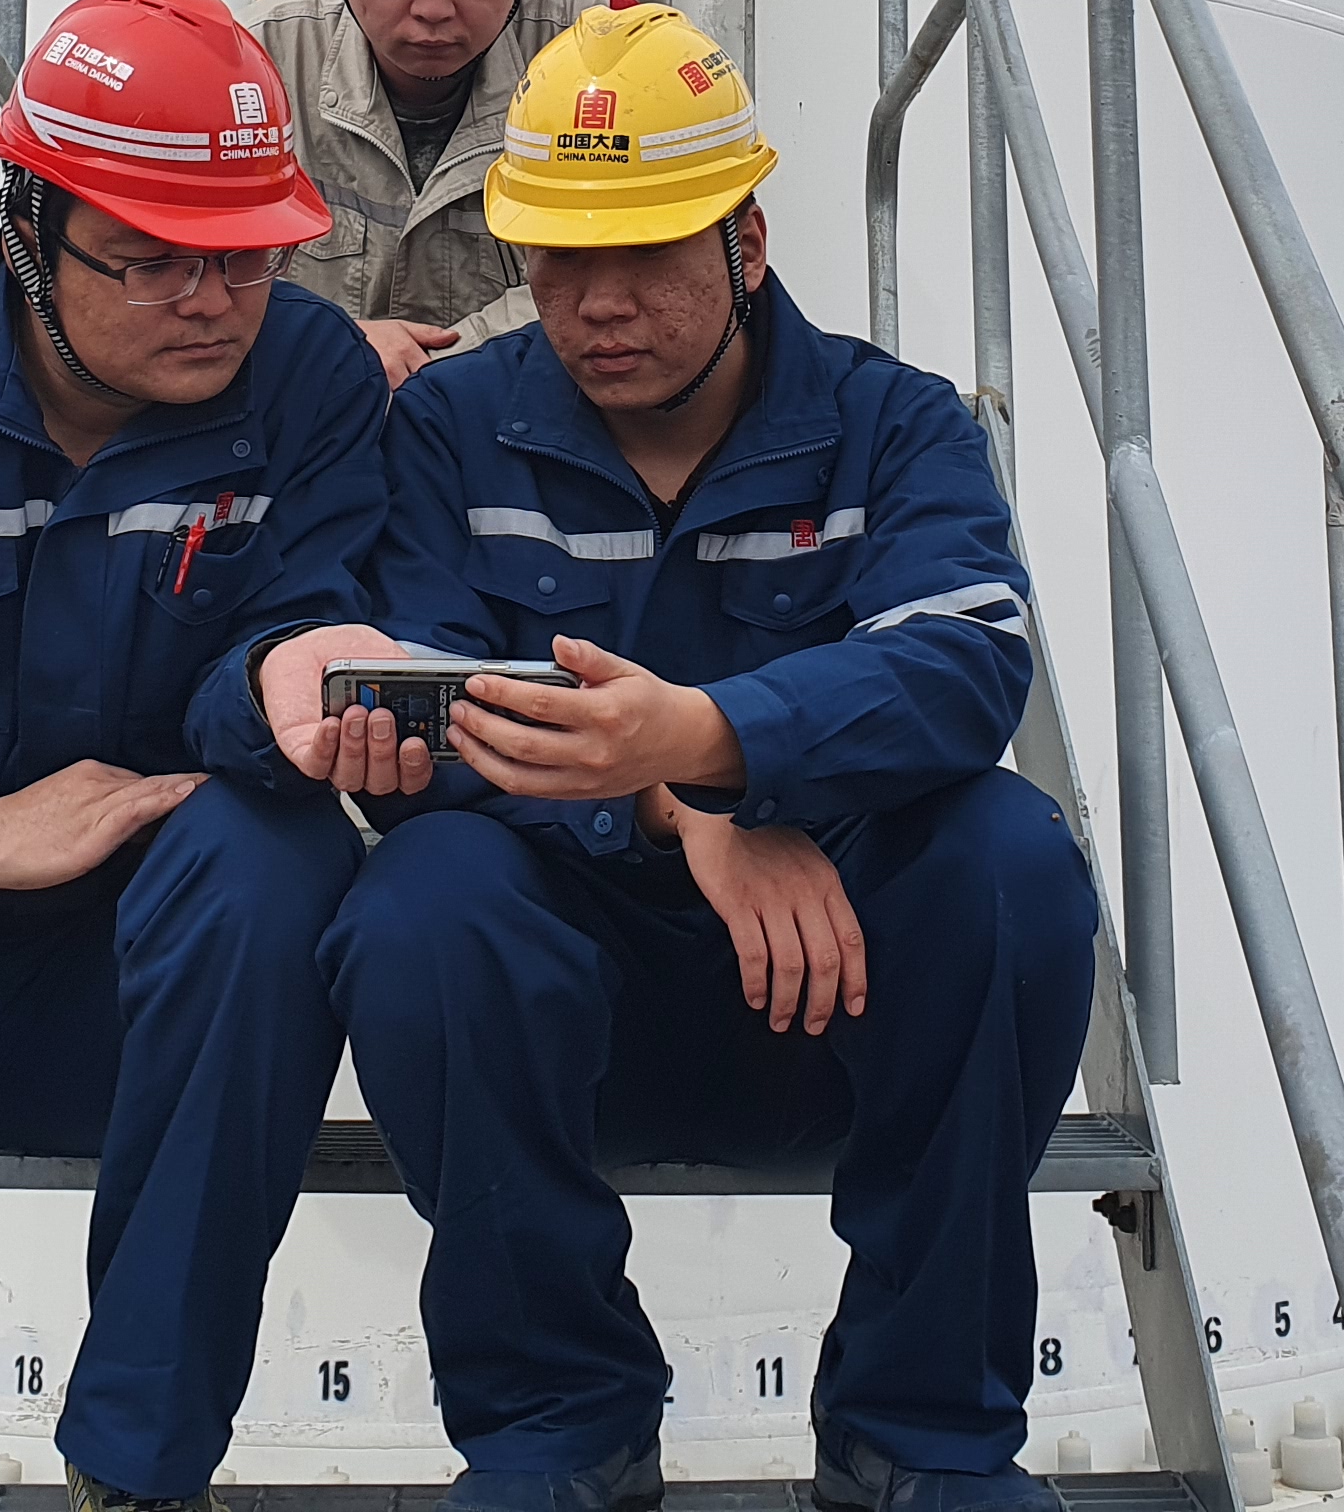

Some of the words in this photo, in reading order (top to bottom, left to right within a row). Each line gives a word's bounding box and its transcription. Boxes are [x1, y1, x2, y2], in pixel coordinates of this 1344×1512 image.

[64, 57, 89, 77] CHINA
[88, 66, 124, 92] DATANG
[71, 42, 135, 81] 中国大唐
[218, 127, 279, 148] 中国大唐
[219, 148, 250, 161] CHINA
[252, 146, 279, 157] DATANG
[557, 133, 630, 151] 中国大唐
[557, 152, 587, 162] CHINA
[588, 152, 630, 164] DATANG
[1205, 1316, 1223, 1353] 6
[1274, 1300, 1291, 1337] 5
[1039, 1337, 1063, 1376] 8
[14, 1355, 44, 1396] 18
[318, 1359, 351, 1402] 15
[755, 1357, 784, 1397] 11
